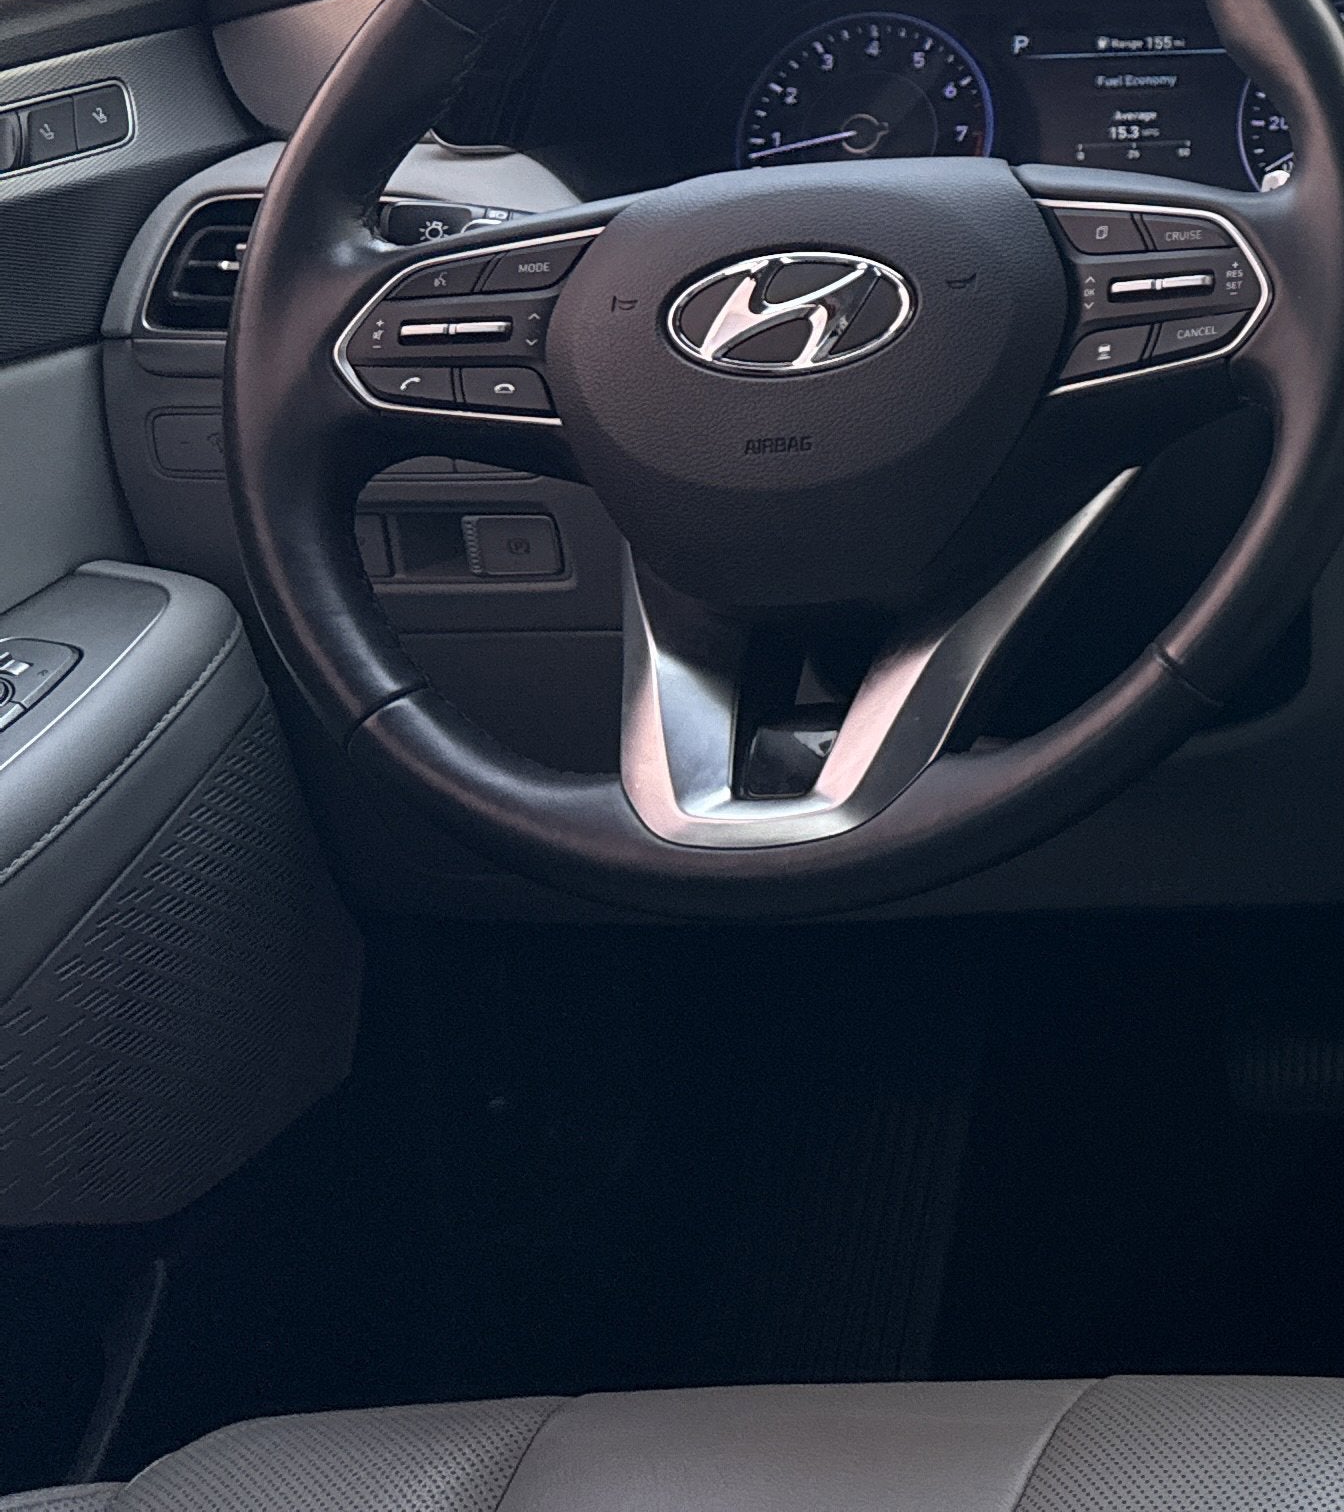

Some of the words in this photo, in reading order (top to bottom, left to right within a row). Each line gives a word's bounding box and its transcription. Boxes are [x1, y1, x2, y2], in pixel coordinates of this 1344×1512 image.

[865, 40, 880, 56] 4
[1012, 34, 1030, 55] P
[821, 53, 834, 70] 3
[912, 50, 925, 69] 5
[1096, 75, 1123, 88] Fuel
[1124, 74, 1178, 88] Economy
[784, 87, 798, 105] 2
[943, 81, 958, 99] 6
[1114, 110, 1158, 123] Average
[955, 125, 969, 142] 7
[1109, 125, 1140, 141] 15.3
[1165, 229, 1202, 242] CRUISE
[517, 261, 551, 274] MODE
[1225, 269, 1244, 279] RES
[1225, 281, 1244, 291] SET
[1176, 324, 1218, 340] CANCEL
[744, 434, 814, 456] AIRBAG
